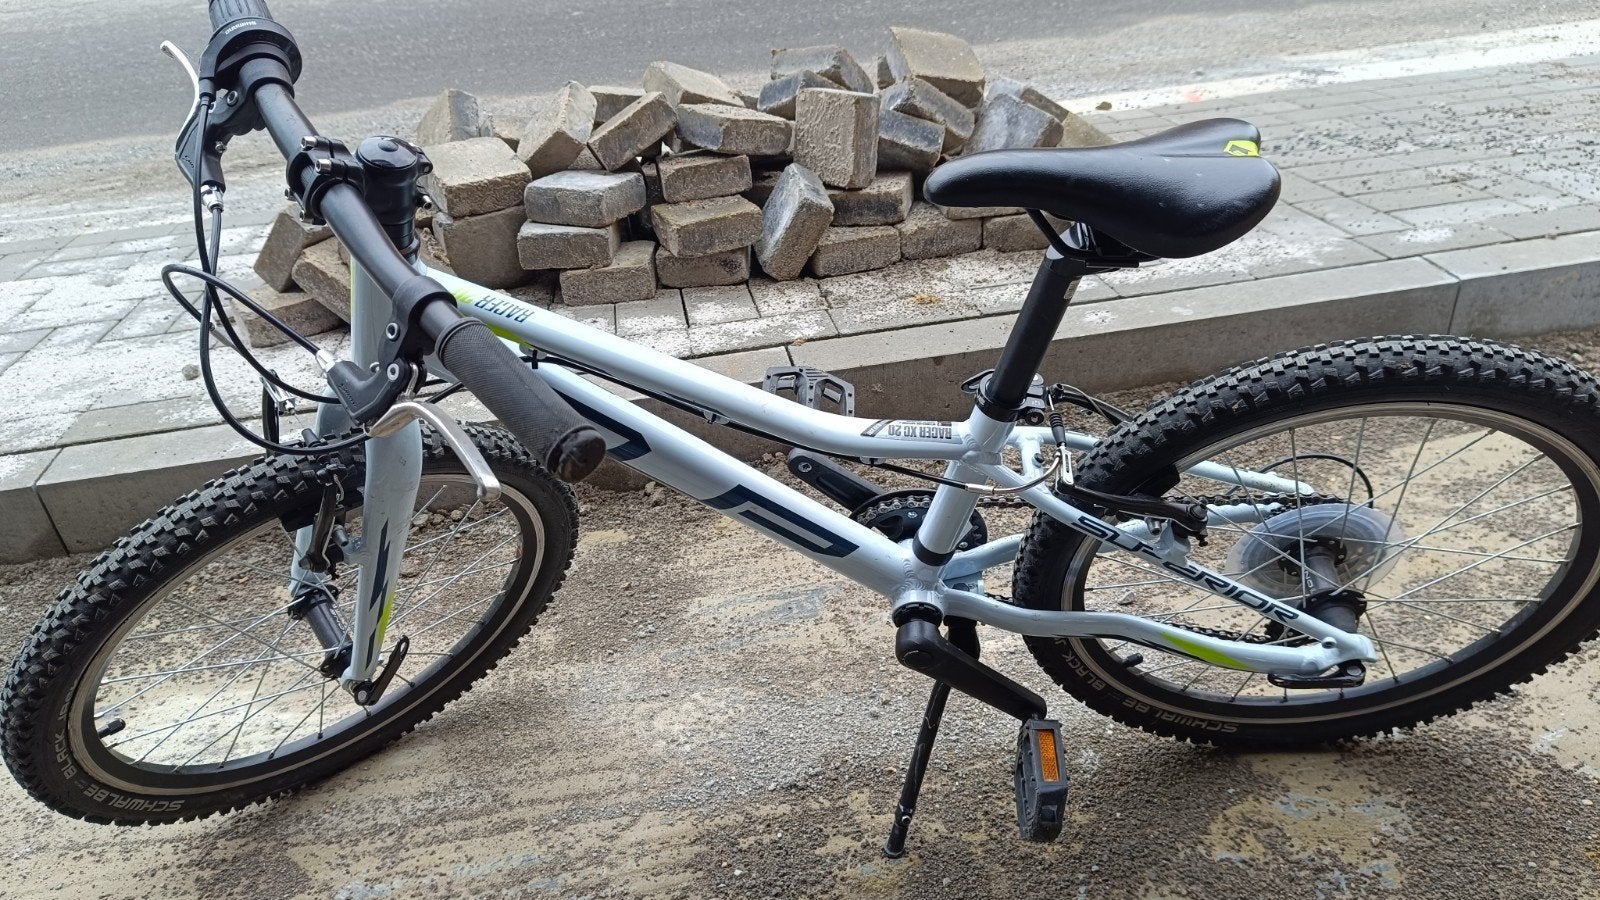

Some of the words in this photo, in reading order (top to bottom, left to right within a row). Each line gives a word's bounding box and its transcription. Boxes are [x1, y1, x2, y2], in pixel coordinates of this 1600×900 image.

[474, 295, 535, 323] RACER
[888, 425, 902, 436] 20
[903, 425, 918, 438] XC
[918, 426, 952, 440] RACER
[1061, 650, 1106, 691] BLACK
[1122, 696, 1239, 733] SCHWALBE
[54, 729, 78, 779] BLACK
[83, 783, 185, 812] SCHWALBE
